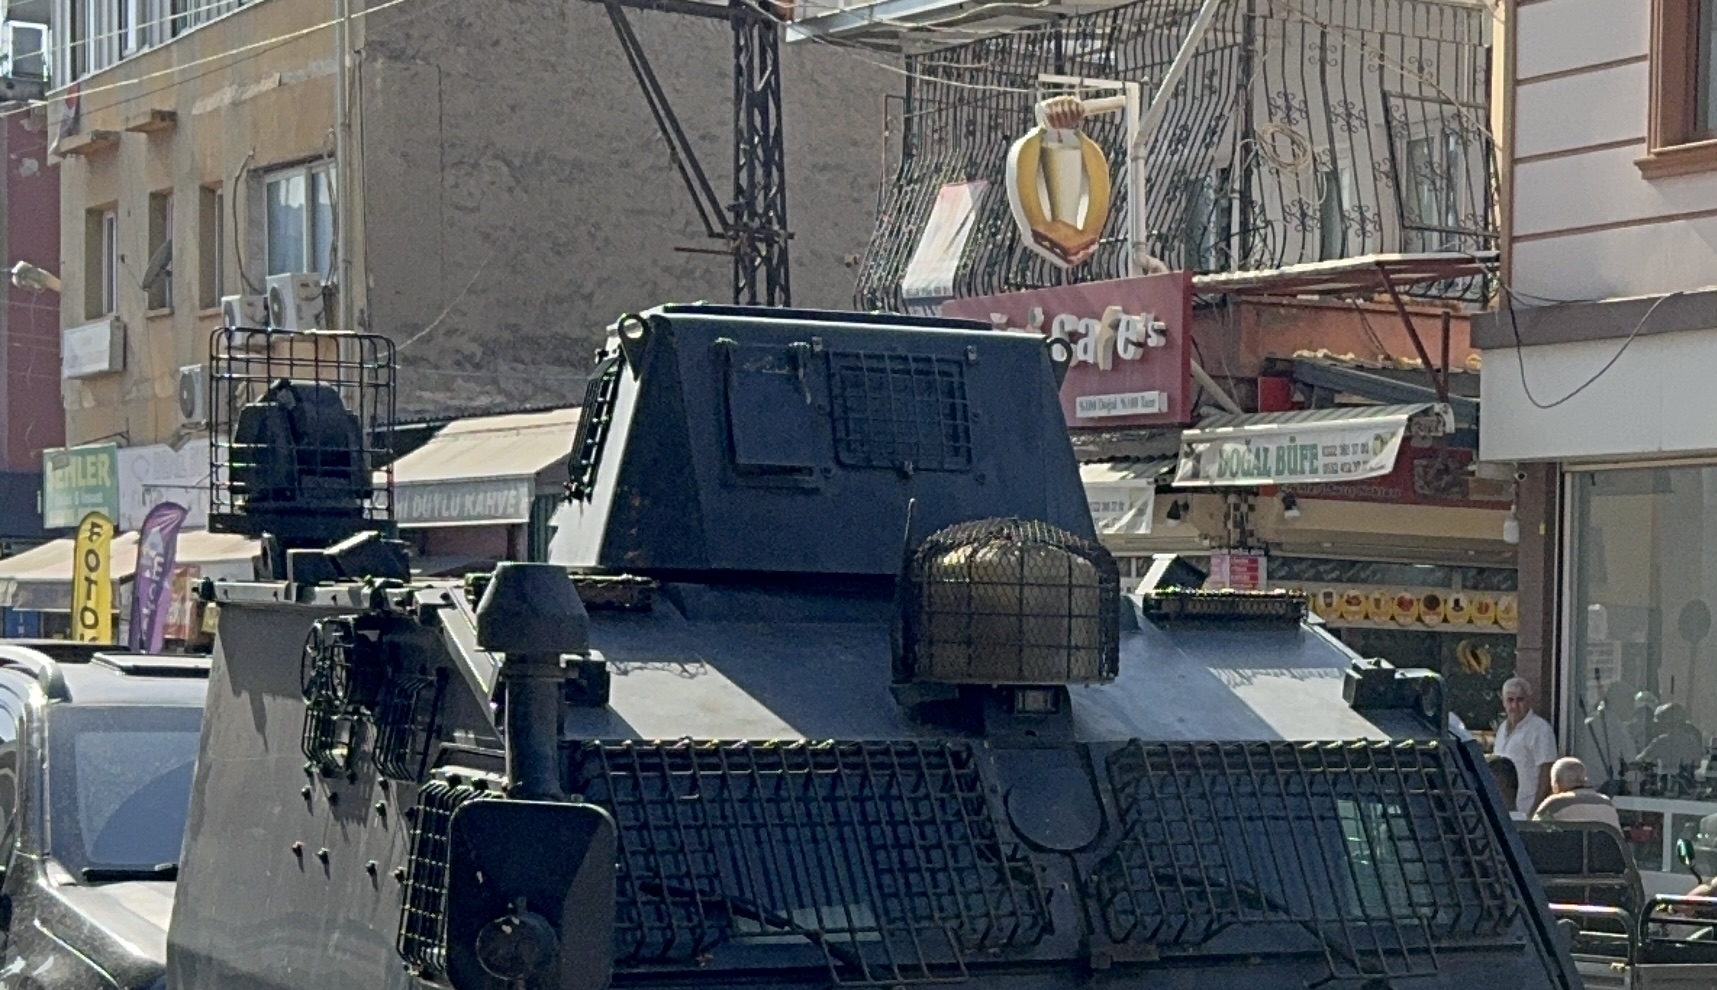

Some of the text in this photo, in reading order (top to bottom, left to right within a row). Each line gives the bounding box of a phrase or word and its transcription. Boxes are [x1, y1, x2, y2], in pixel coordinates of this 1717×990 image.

[1217, 438, 1272, 478] DOĞAL
[1275, 436, 1319, 476] BÜFE
[464, 489, 517, 517] KAHVE
[79, 521, 104, 642] FOTO
